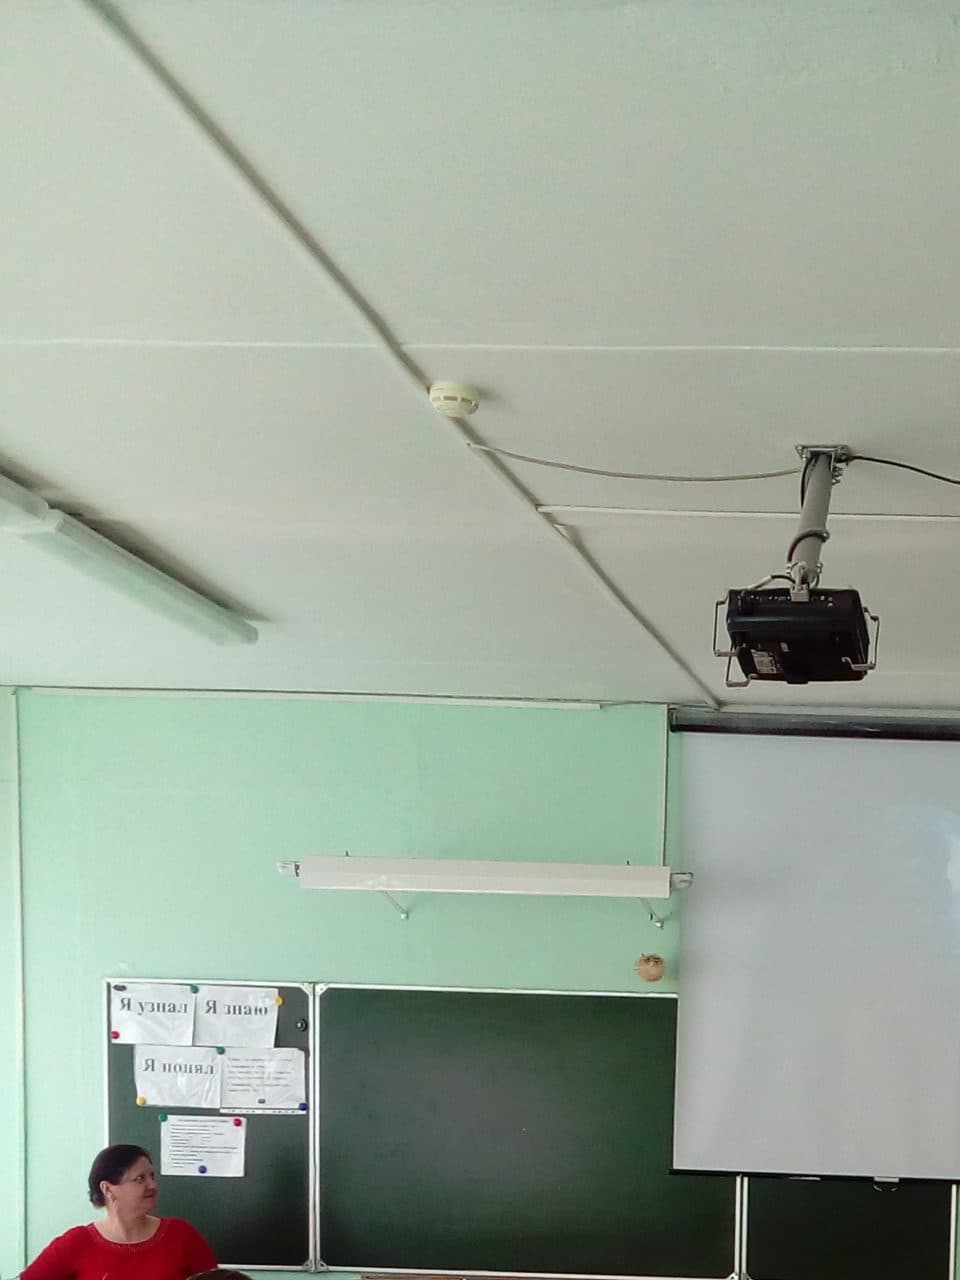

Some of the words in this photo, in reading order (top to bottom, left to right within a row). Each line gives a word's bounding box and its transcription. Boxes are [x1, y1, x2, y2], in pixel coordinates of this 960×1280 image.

[119, 997, 132, 1012] Я
[137, 1001, 188, 1015] узнал
[205, 999, 217, 1014] Я
[224, 1003, 268, 1015] знаю
[142, 1058, 155, 1072] Я
[162, 1062, 214, 1075] понял
